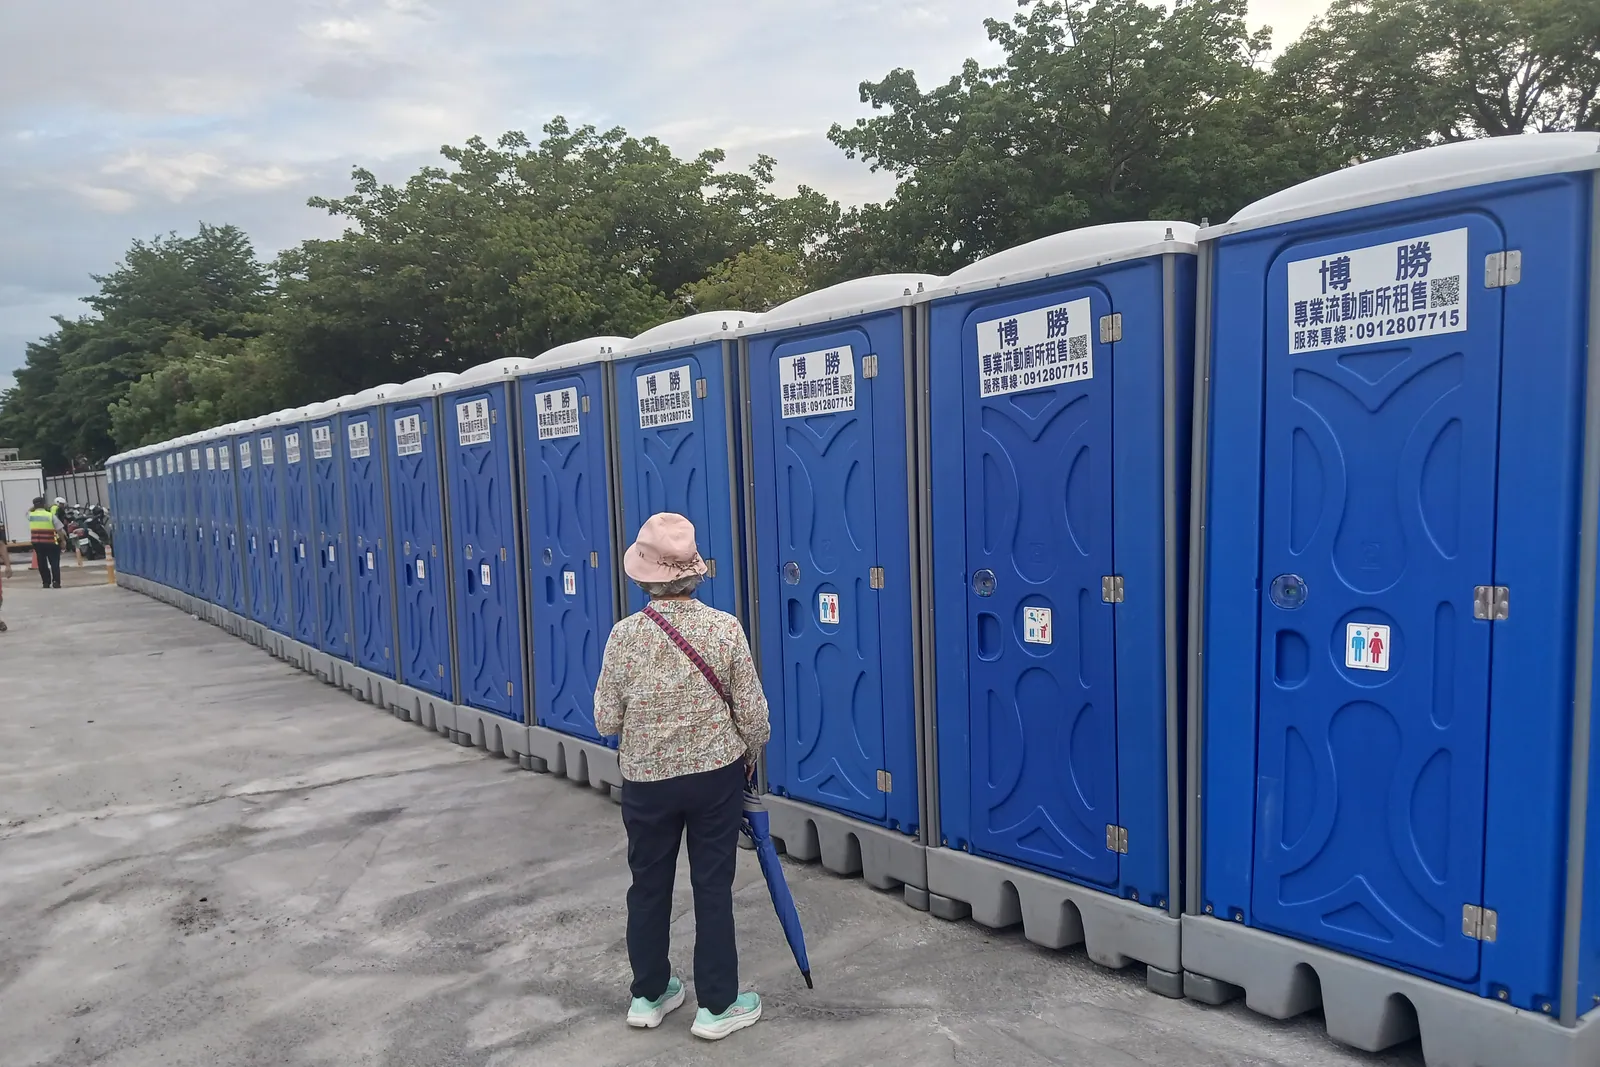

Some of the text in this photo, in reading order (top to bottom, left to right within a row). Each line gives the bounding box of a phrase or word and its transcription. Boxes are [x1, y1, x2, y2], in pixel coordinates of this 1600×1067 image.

[1293, 281, 1428, 328] 專業流動廁所租售
[982, 339, 1068, 377] 專業流動廁所租售
